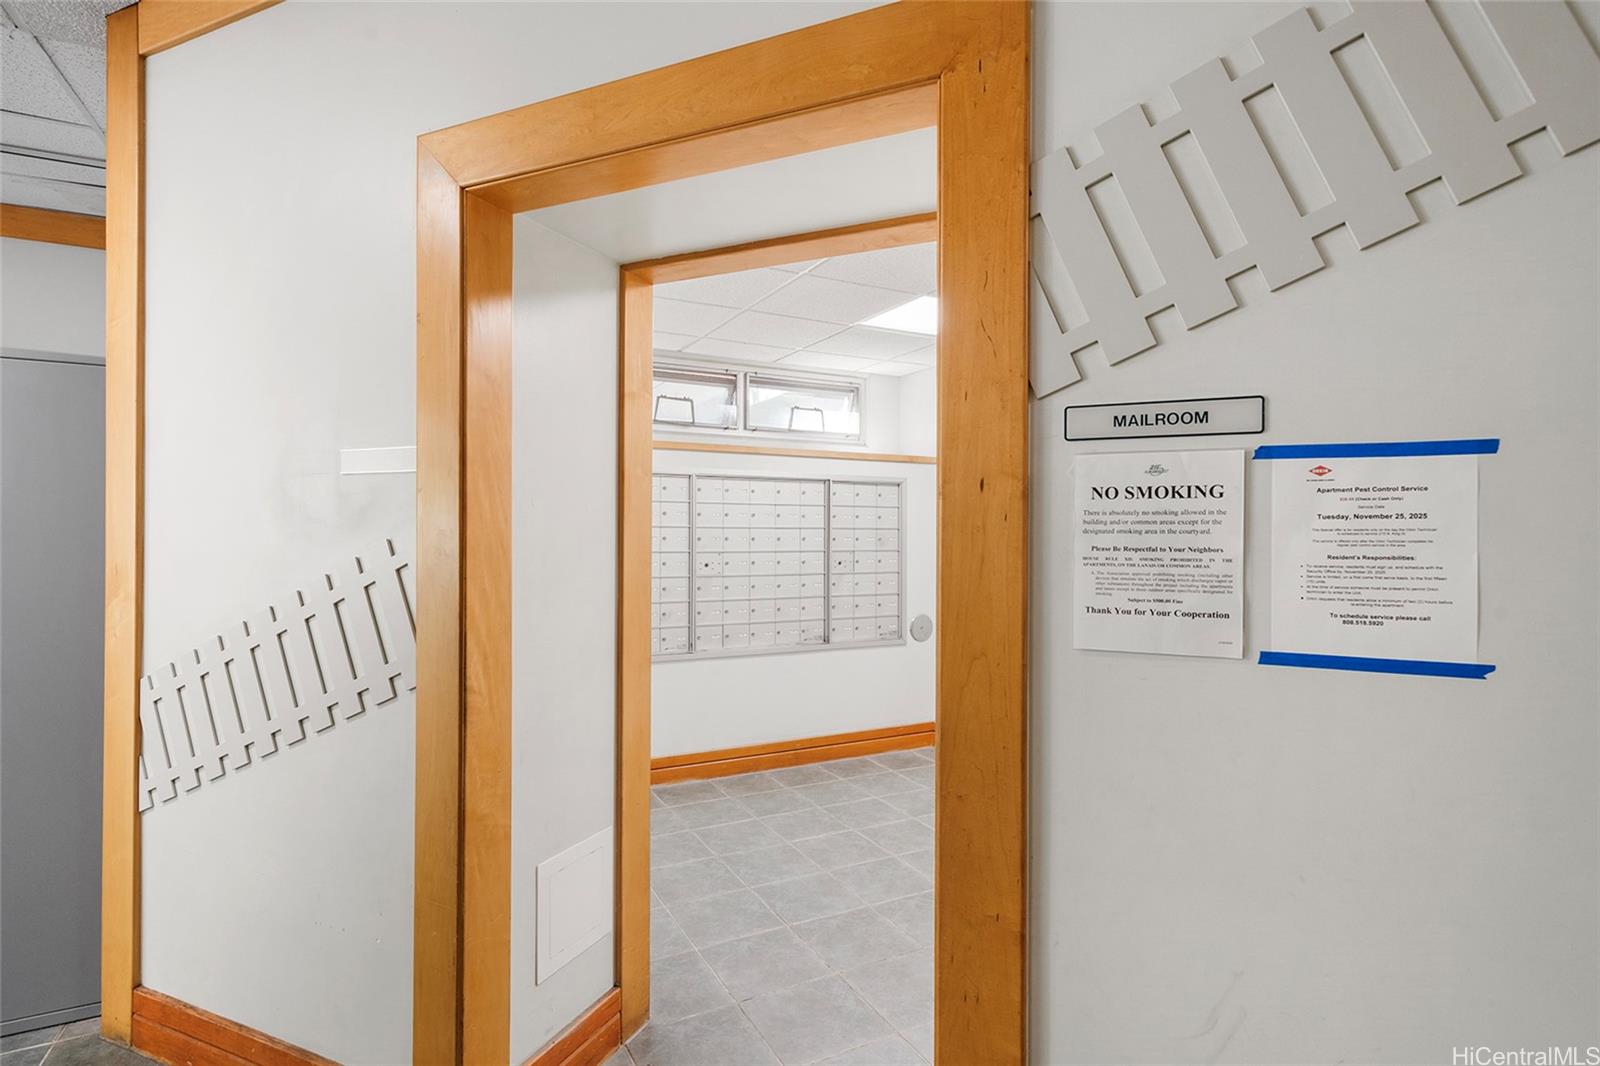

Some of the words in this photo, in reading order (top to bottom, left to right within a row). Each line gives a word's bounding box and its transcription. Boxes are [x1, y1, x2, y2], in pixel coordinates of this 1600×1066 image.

[1113, 411, 1209, 428] MAILROOM
[1091, 486, 1119, 500] NO
[1124, 484, 1225, 500] SMOKING
[1316, 487, 1353, 495] Apartment
[1108, 509, 1140, 518] absolutely
[1151, 509, 1179, 517] smoking
[1317, 513, 1352, 521] Tuesday,
[1408, 512, 1428, 520] 2025
[1082, 528, 1115, 536] designated
[1178, 528, 1212, 536] courtyard.
[1123, 545, 1158, 554] Respectful
[1187, 546, 1224, 554] Neighbors
[1086, 606, 1112, 615] Thank
[1114, 607, 1132, 616] You
[1134, 607, 1147, 616] for
[1149, 608, 1172, 617] Your
[1174, 609, 1230, 620] Cooperation
[1395, 614, 1417, 622] please
